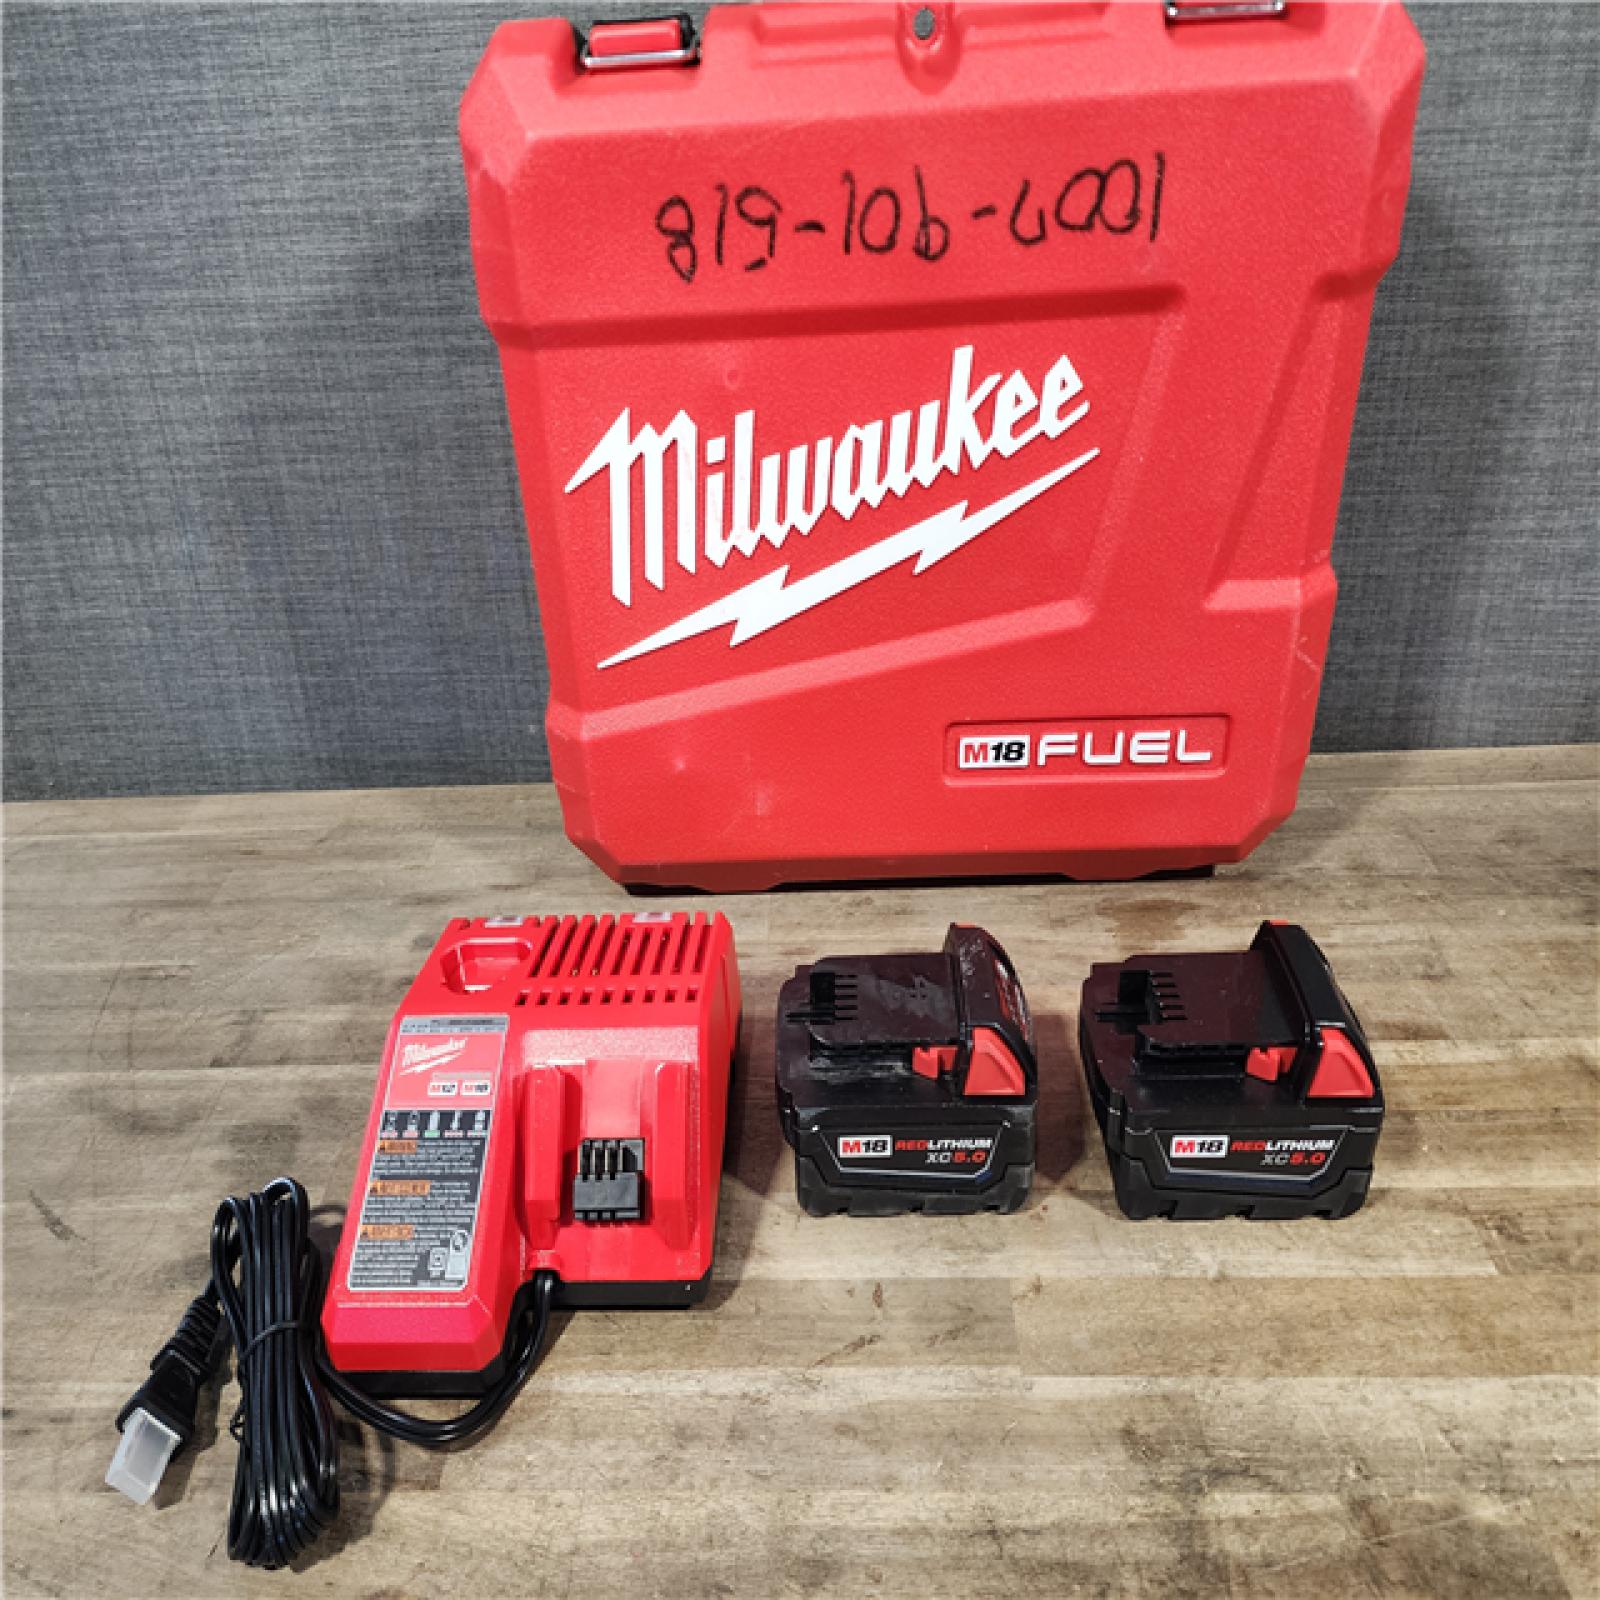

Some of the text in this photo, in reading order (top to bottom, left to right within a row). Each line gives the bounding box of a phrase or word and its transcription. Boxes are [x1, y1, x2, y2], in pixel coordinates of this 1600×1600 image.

[565, 344, 1090, 607] Milwaukee
[963, 729, 1212, 767] M18 FUEL
[842, 1139, 888, 1153] M18
[1174, 1139, 1223, 1153] M18
